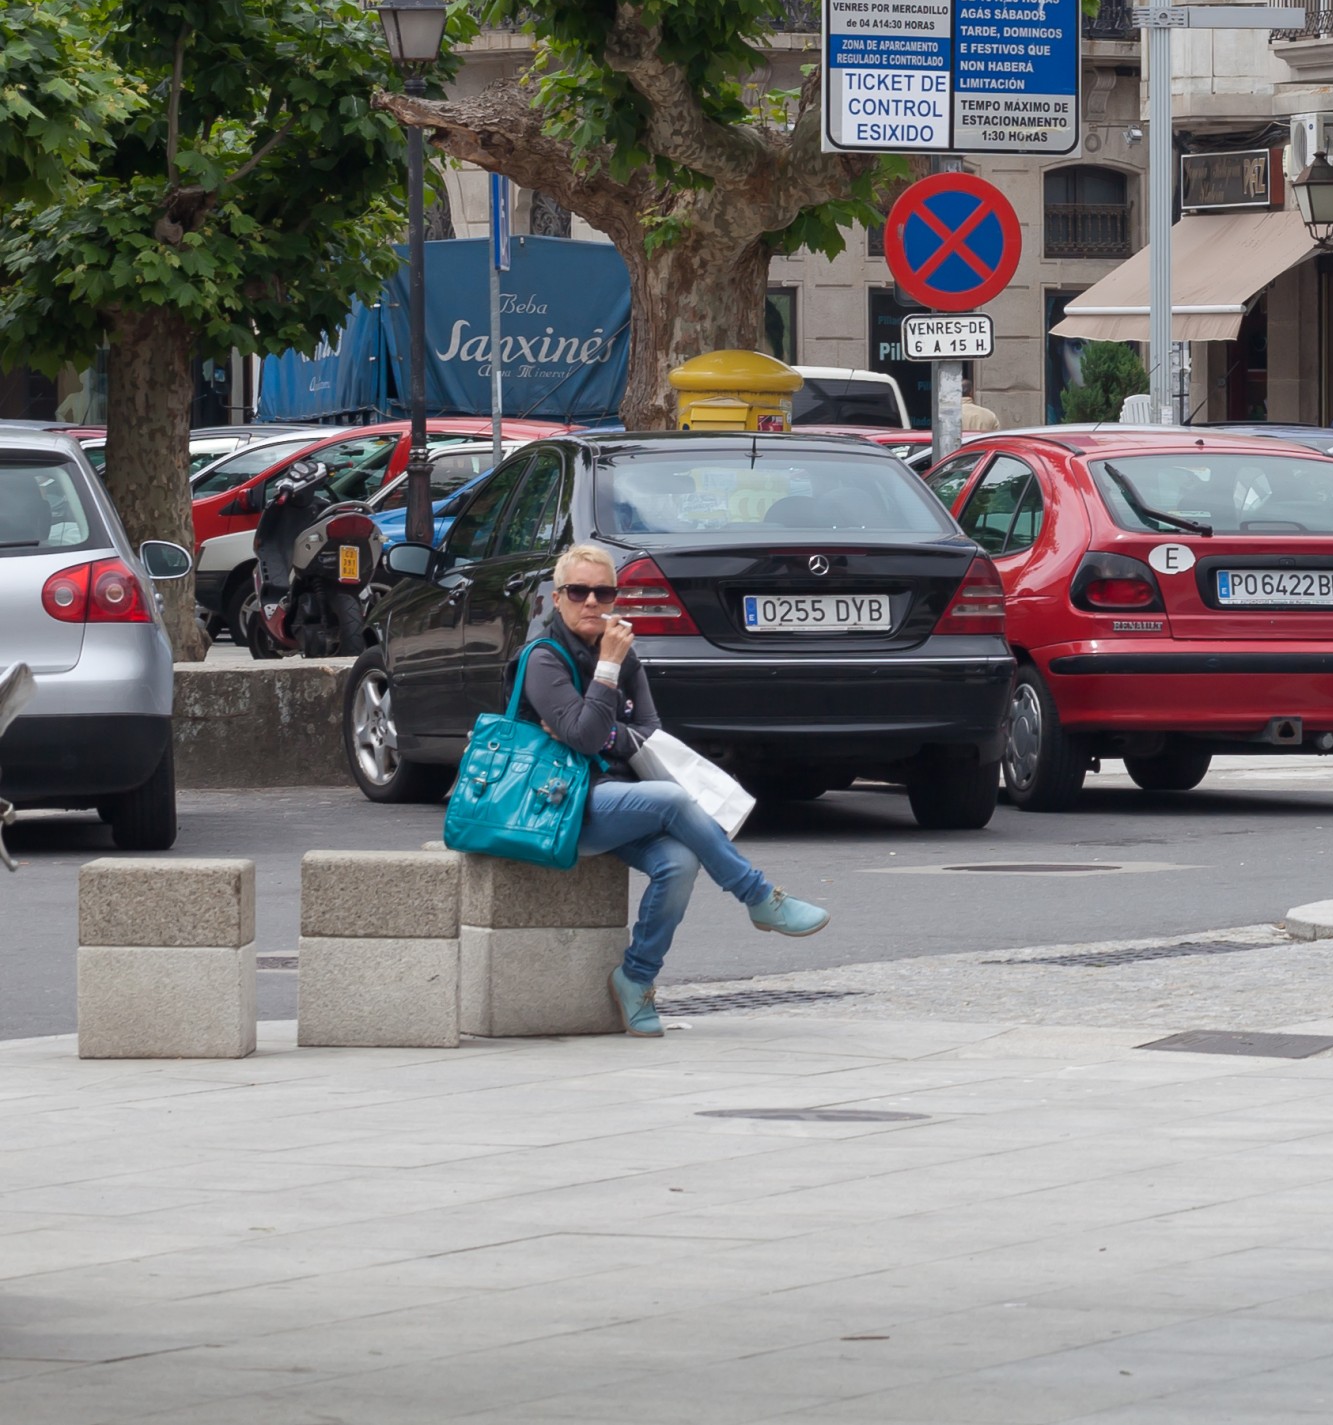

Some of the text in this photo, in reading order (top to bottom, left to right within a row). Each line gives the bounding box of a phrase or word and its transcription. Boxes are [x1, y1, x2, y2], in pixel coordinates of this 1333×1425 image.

[833, 2, 948, 15] VENRES POR MERCADILLO
[961, 7, 1046, 21] AGÁS SÁBADOS
[846, 19, 857, 28] de
[859, 19, 870, 28] 04
[904, 20, 935, 30] HORAS
[961, 26, 1062, 39] TARDE, DOMINGOS
[842, 40, 938, 52] ZONA DE APARCAMENTO
[961, 44, 1050, 56] E FESTIVOS QUE
[837, 54, 943, 66] REGULADO E CONTROLADO
[961, 60, 1033, 72] NON HABERÁ
[845, 73, 946, 92] TICKET DE
[960, 77, 1025, 90] LIMITACIÓN
[849, 98, 942, 117] CONTROL
[961, 99, 1068, 113] TEMPO MÁXIMO DE
[962, 116, 1067, 128] ESTACIONAMENTO
[857, 124, 933, 142] ESIXIDO
[982, 131, 1047, 142] 1:30 HORAS
[500, 293, 547, 315] Beba
[915, 341, 922, 352] 6
[934, 340, 941, 352] A
[950, 340, 966, 351] 15
[1166, 547, 1179, 569] E
[763, 600, 825, 622] 0255
[836, 599, 882, 622] DYB
[1113, 621, 1162, 632] RENAULT
